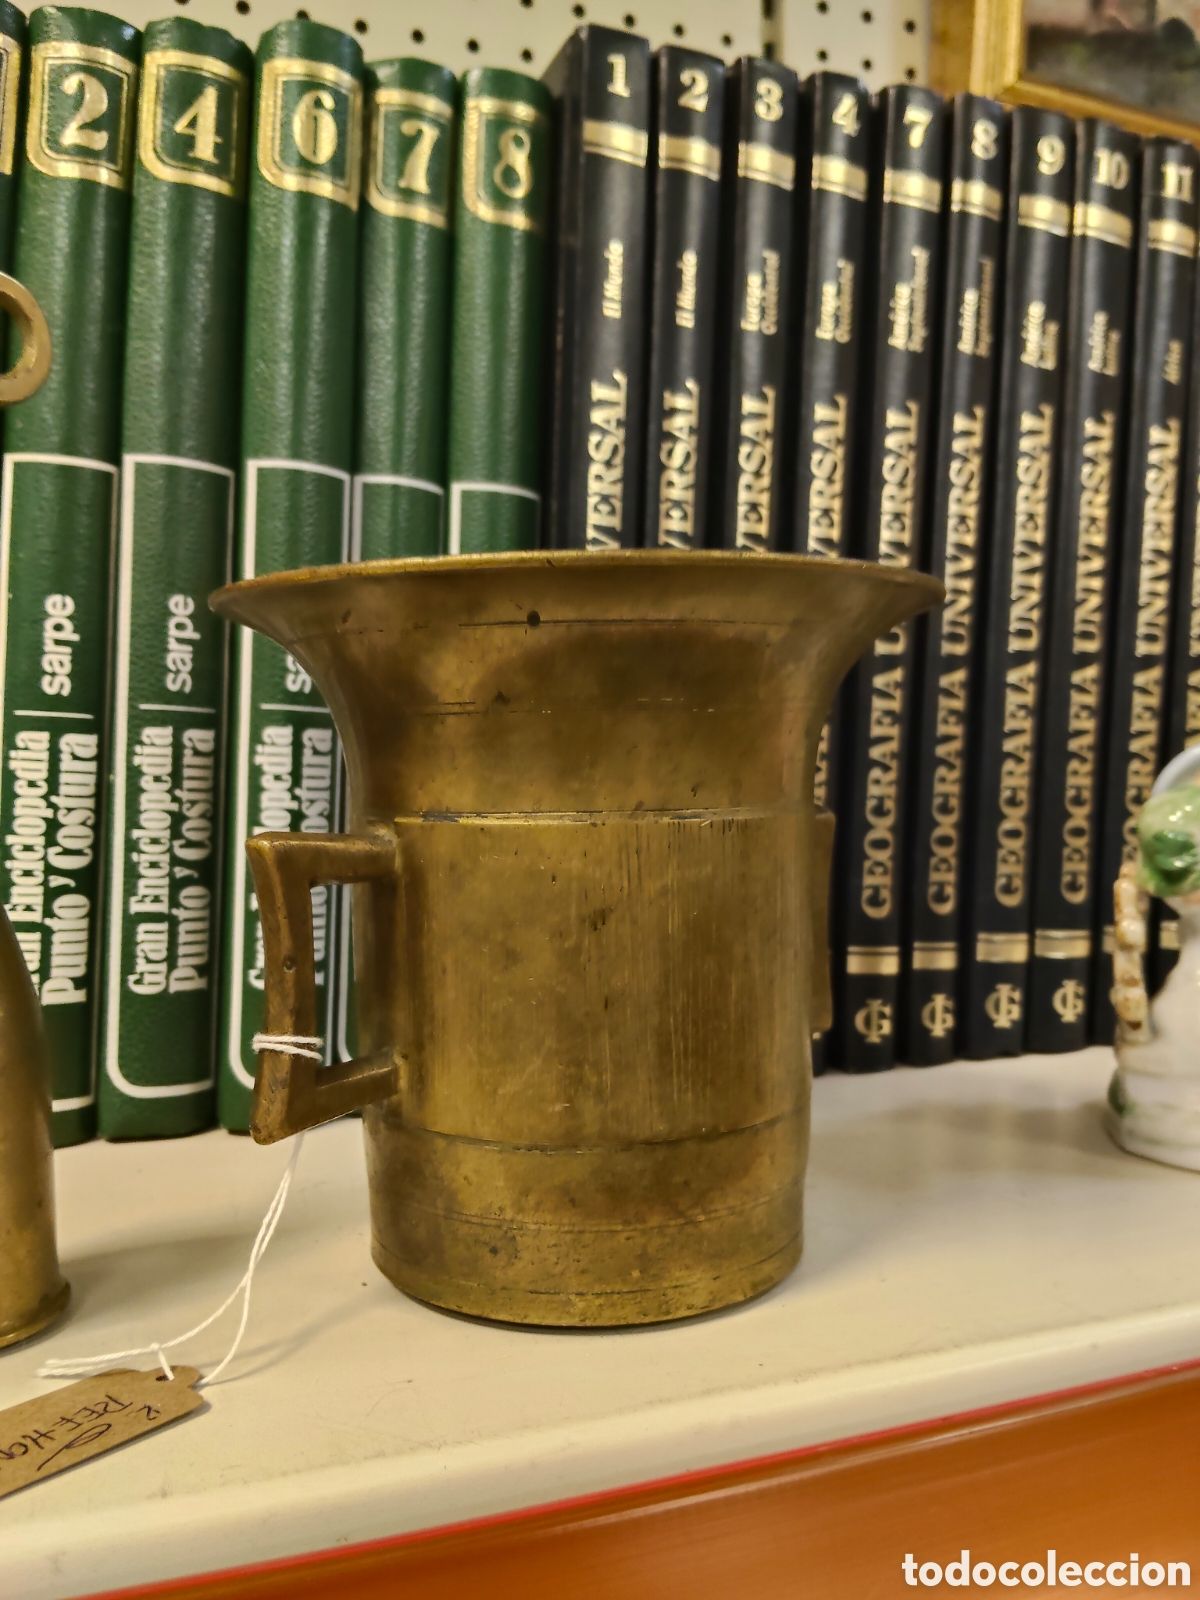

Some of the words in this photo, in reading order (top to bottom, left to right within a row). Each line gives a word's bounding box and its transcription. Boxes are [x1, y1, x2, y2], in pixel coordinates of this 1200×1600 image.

[59, 72, 109, 151] 2
[607, 54, 630, 98] 1
[679, 69, 709, 112] 2
[754, 79, 783, 122] 3
[832, 93, 860, 137] 4
[173, 85, 223, 164] 4
[291, 90, 338, 165] 6
[400, 119, 440, 195] 7
[493, 129, 532, 199] 8
[903, 106, 933, 149] 7
[971, 119, 998, 161] 8
[1036, 136, 1066, 176] 9
[1093, 147, 1129, 190] 10
[1161, 163, 1194, 203] 11
[941, 404, 984, 656] UNIVERSAL
[1008, 403, 1053, 653] UNIVERSAL
[1073, 410, 1115, 654] UNIVERSAL
[1135, 417, 1181, 658] UNIVERSAL
[41, 593, 80, 697] sarpe
[166, 593, 200, 694] sarpe
[47, 733, 98, 871] Costura
[129, 725, 180, 915] Enciclopedia
[173, 728, 215, 862] Costura
[861, 667, 904, 920] GEOGRAFIA
[927, 667, 967, 917] GEOGRAFIA
[995, 659, 1037, 907] GEOGRAFIA
[1060, 662, 1100, 905] GEOGRAFIA
[5, 730, 54, 923] Enciclopedia
[49, 874, 76, 888] y
[173, 864, 199, 880] y
[41, 894, 90, 1006] Punto
[128, 920, 169, 996] Gran
[168, 885, 211, 994] Punto
